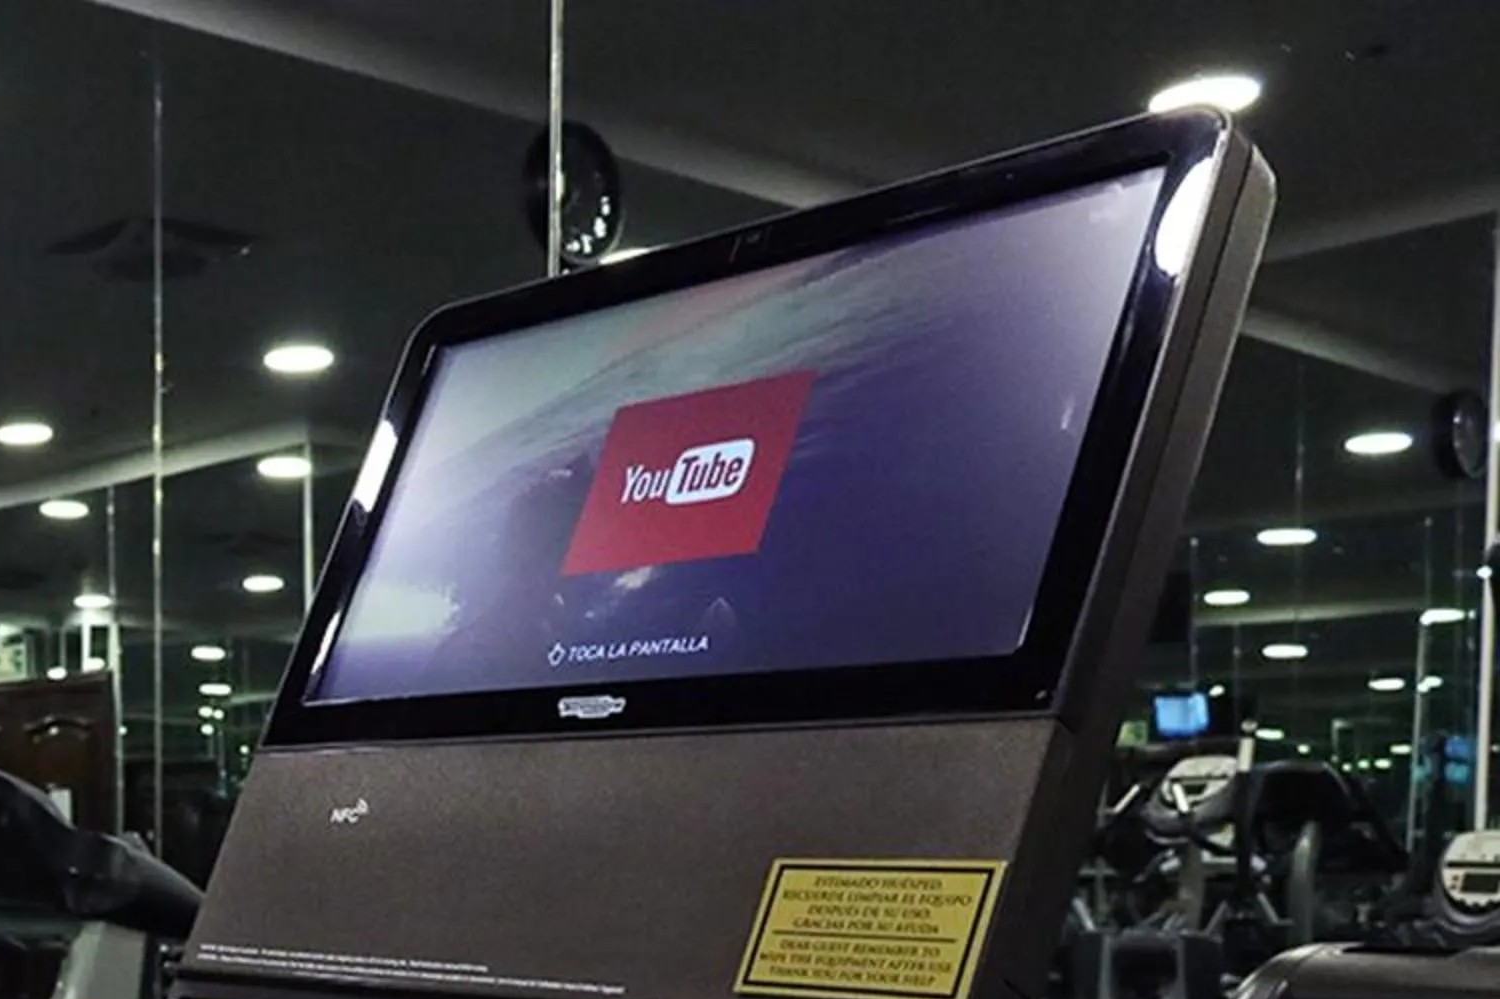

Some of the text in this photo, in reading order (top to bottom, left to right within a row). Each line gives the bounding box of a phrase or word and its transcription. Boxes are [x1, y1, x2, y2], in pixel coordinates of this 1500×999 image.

[621, 450, 746, 504] YouTube
[568, 635, 709, 662] TOCA LA PANTALLA
